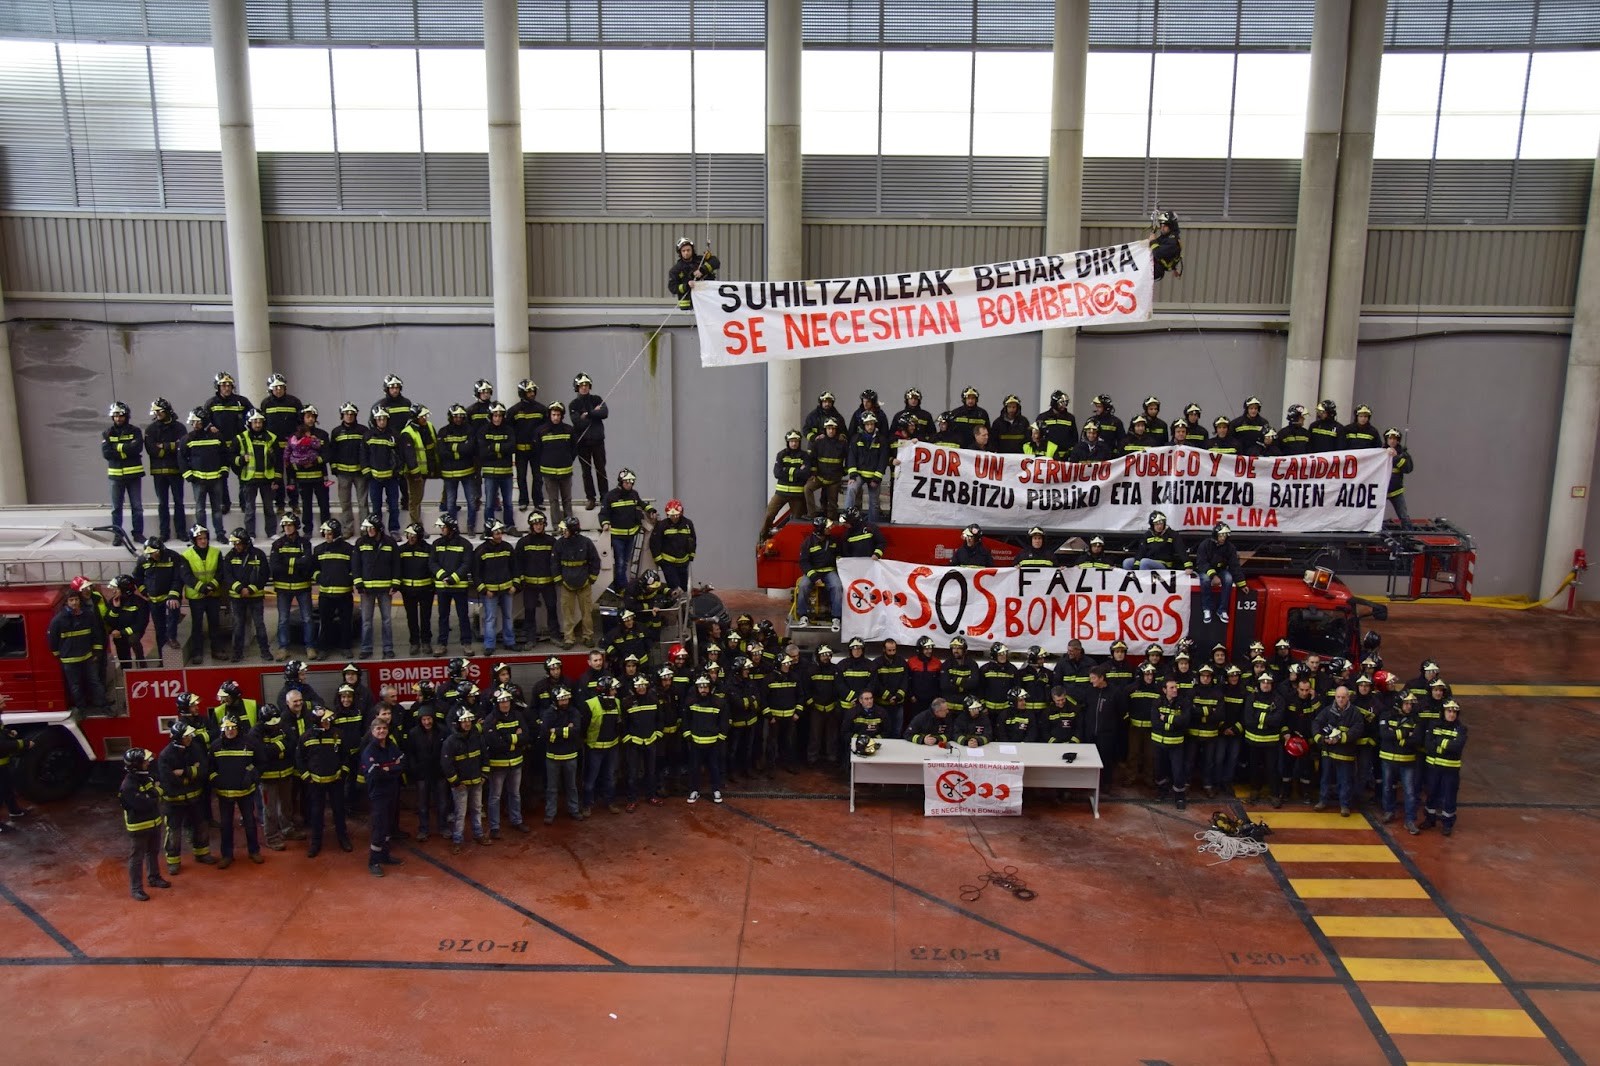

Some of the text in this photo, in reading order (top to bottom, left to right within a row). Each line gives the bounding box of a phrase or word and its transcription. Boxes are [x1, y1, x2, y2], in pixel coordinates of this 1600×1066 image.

[718, 244, 1139, 313] SUHILTZAILEAK BEHAR DIRA
[723, 279, 1137, 355] SE NECESITAN BOMBER@S
[913, 447, 960, 477] POR
[975, 454, 1004, 481] UN
[1210, 453, 1222, 477] Y
[1235, 455, 1259, 478] DE
[1110, 481, 1142, 505] ETA
[1270, 483, 1325, 508] BATEN
[1335, 483, 1378, 509] ALDE
[1183, 506, 1279, 528] ANE-LNA
[1018, 568, 1177, 597] FALTAN
[900, 566, 999, 640] S.O.S.
[1237, 600, 1257, 610] L32
[1005, 594, 1183, 645] BOMBER@S
[379, 664, 481, 681] BOMBES
[150, 680, 181, 698] 112
[438, 938, 529, 953] B-076
